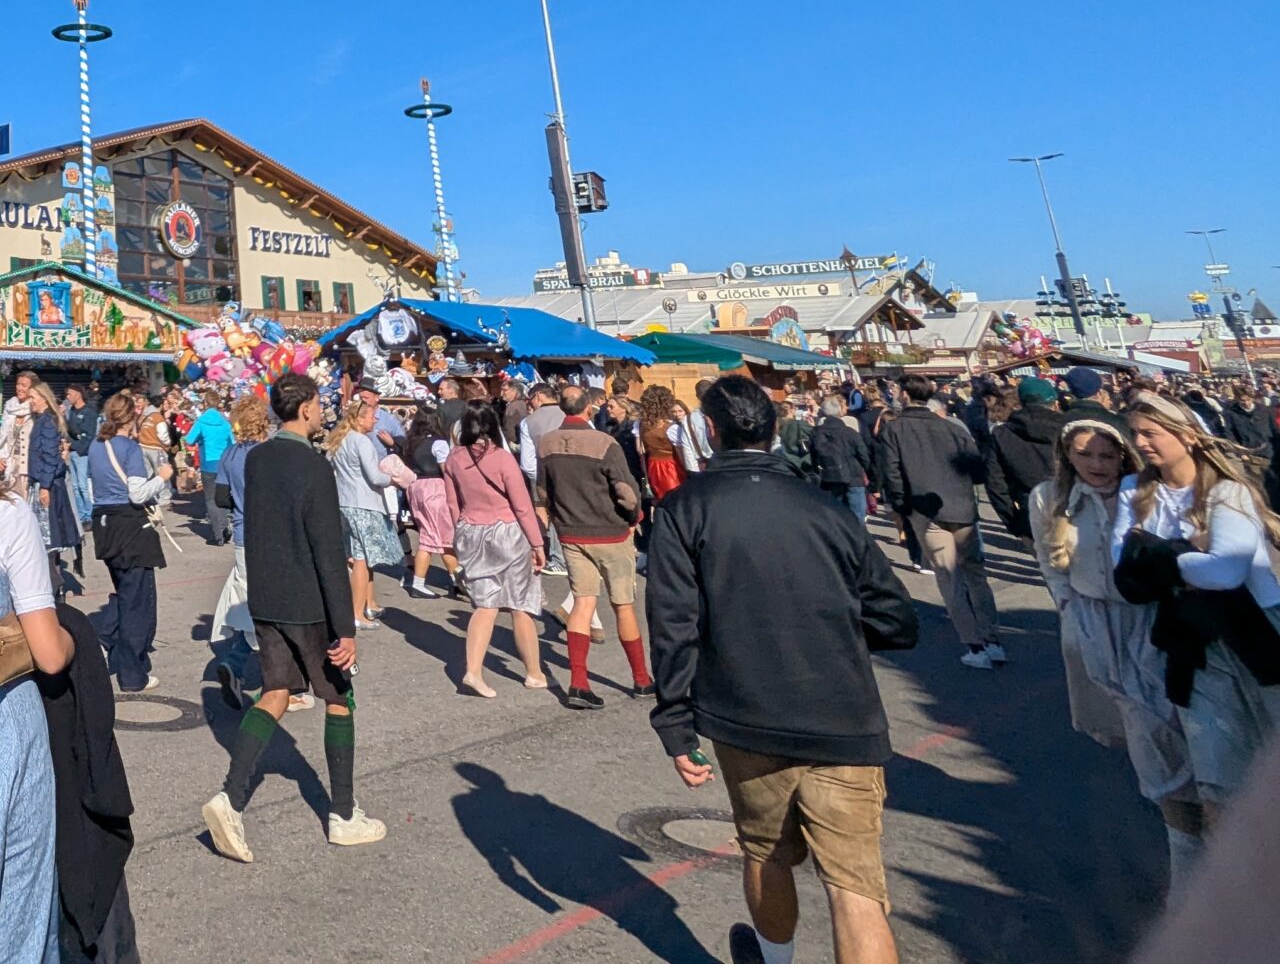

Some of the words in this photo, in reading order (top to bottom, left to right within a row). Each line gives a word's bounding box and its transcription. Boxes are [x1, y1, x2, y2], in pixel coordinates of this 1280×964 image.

[165, 203, 200, 227] PAULANER
[248, 227, 332, 258] FESTZELT
[716, 287, 770, 300] Glöckle
[775, 285, 808, 297] Wirt
[6, 319, 93, 349] PIRSCH
